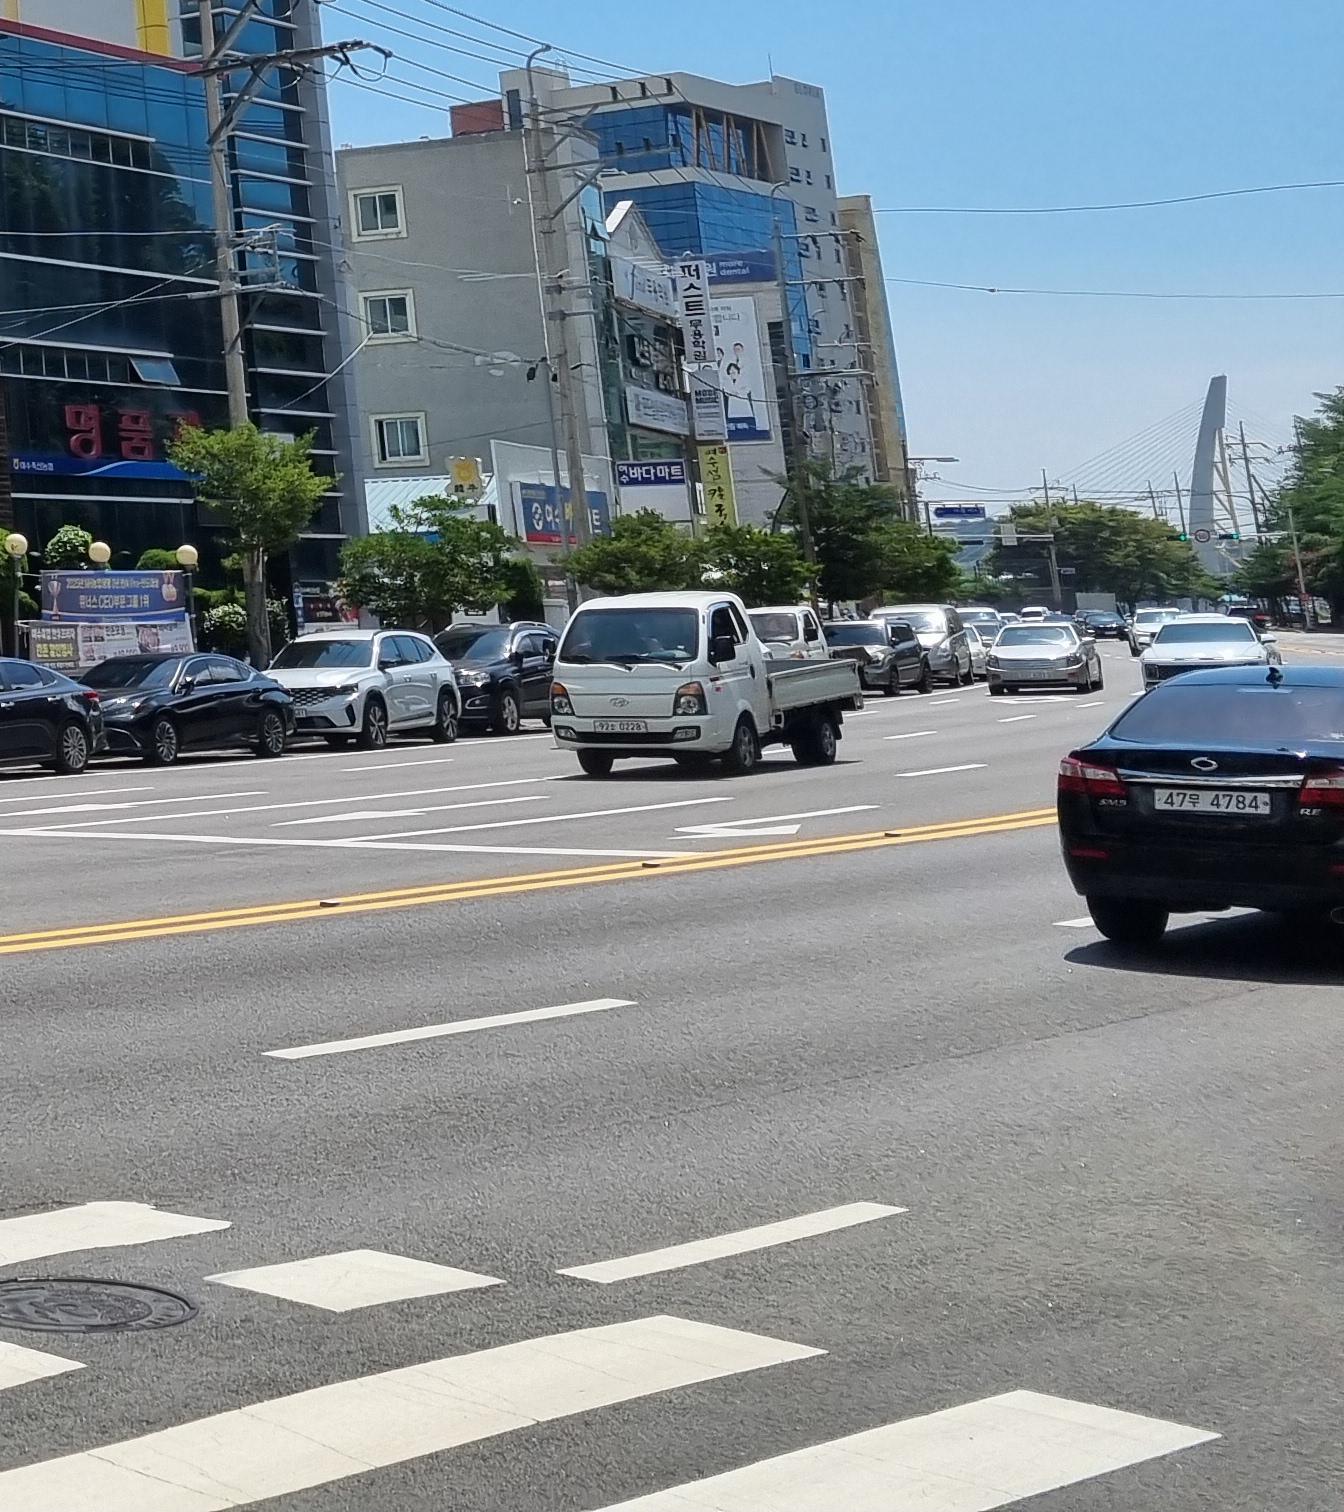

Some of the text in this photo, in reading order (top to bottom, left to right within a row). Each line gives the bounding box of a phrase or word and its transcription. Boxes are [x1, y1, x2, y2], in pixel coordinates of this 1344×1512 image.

[719, 260, 744, 268] more
[719, 266, 750, 277] dental
[64, 404, 201, 460] 명품
[629, 464, 685, 482] 바다마트
[1098, 798, 1127, 807] SM5
[1163, 791, 1261, 811] 47무 4784
[1299, 808, 1322, 817] RE
